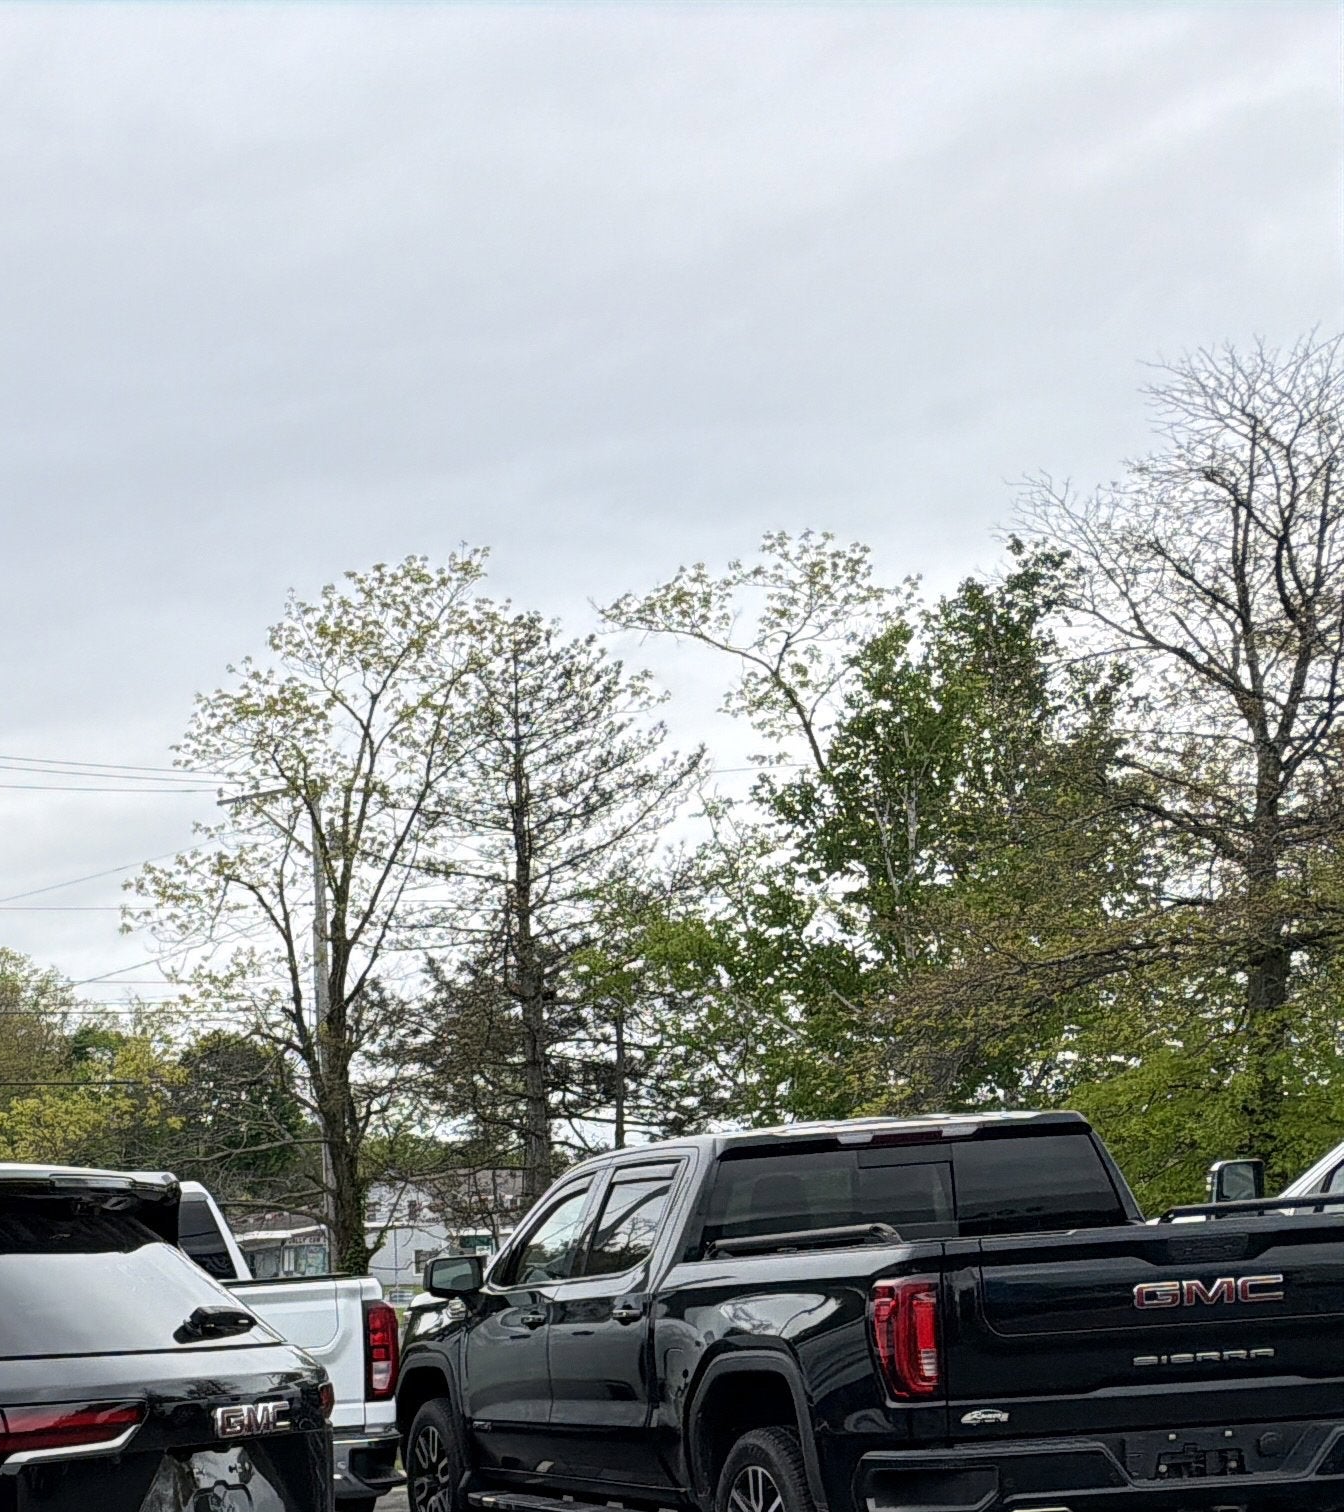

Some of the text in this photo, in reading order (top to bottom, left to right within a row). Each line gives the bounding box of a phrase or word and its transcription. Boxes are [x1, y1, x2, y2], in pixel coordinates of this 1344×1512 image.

[1133, 1274, 1285, 1310] GMC
[1132, 1348, 1275, 1367] SIERRA
[216, 1400, 291, 1439] GMC
